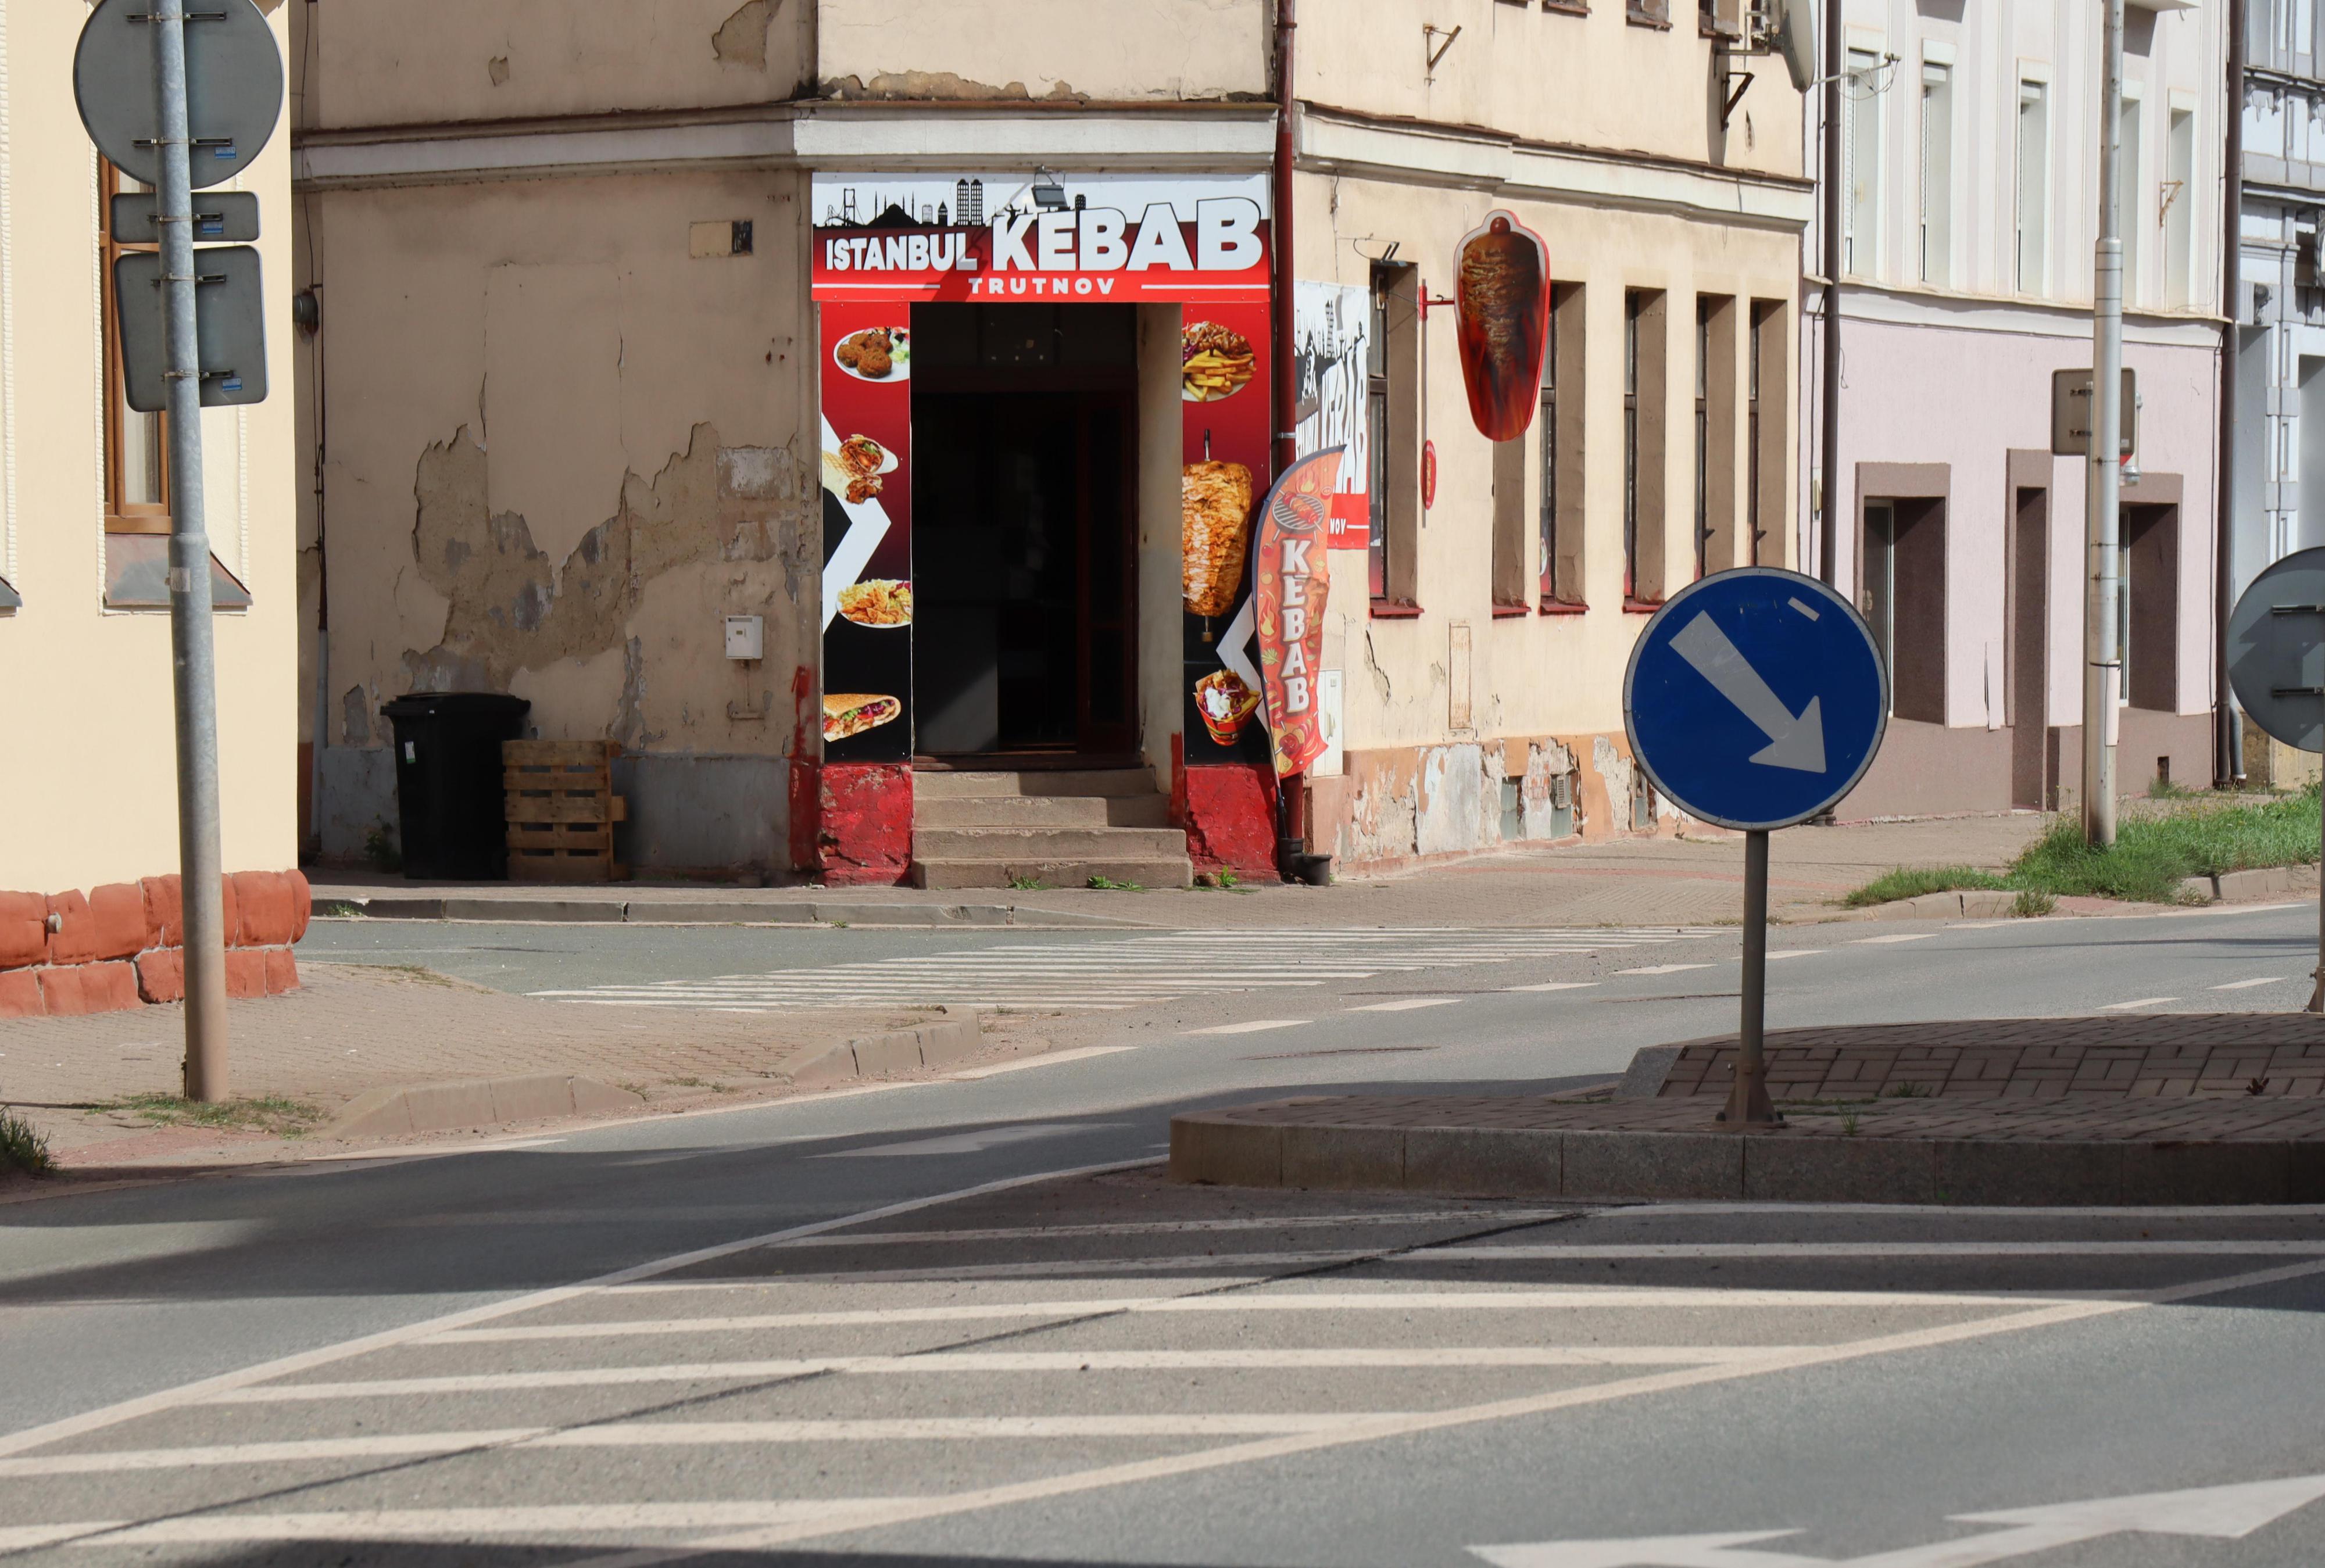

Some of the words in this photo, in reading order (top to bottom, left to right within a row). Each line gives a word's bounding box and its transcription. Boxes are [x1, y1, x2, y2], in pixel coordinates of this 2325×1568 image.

[825, 232, 978, 271] ISTANBUL
[992, 196, 1263, 271] KEBAB
[968, 277, 1115, 295] TRUTNOV
[1280, 538, 1311, 714] KEBAB
